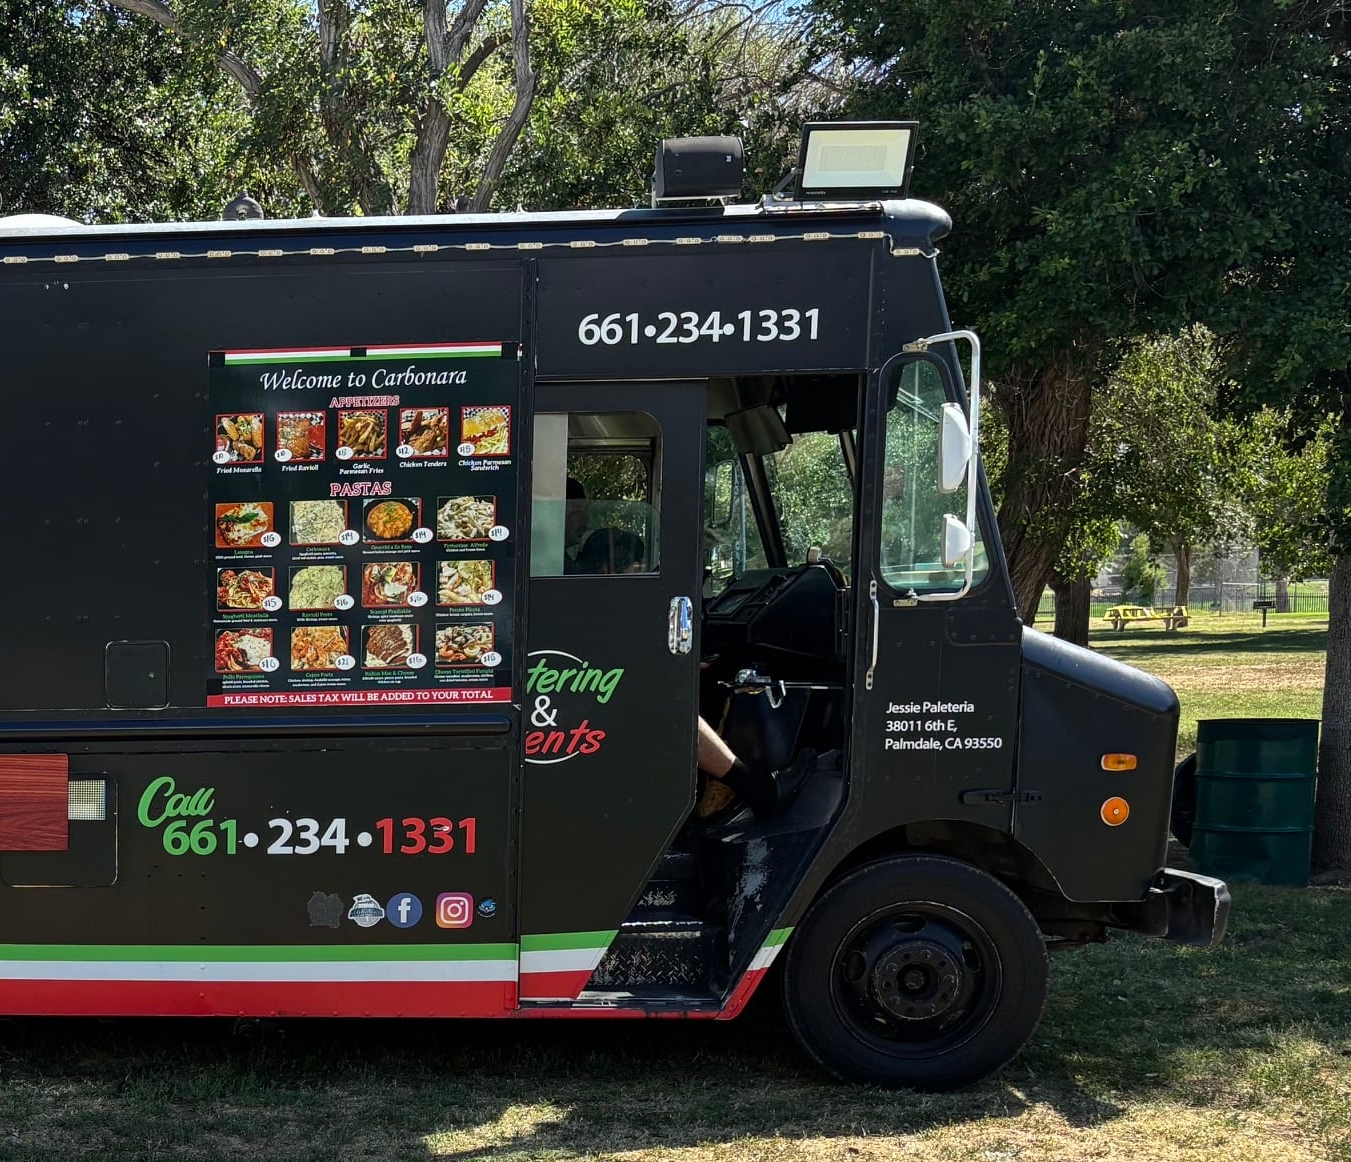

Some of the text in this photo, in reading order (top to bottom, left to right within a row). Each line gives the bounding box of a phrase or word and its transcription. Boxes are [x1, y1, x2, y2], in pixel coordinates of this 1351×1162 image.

[260, 365, 467, 391] Welcome to Carbonara
[329, 395, 400, 408] APPETIZERS
[329, 481, 392, 497] PASTAS
[224, 690, 493, 704] PLEASE NOTE: SALES TAX WILL BE ADDED TO YOUR TOTAL
[530, 695, 558, 727] &
[885, 701, 975, 714] Jessie Paleteria
[885, 720, 958, 733] 38011 6th E,
[525, 719, 606, 755] ents
[885, 737, 1002, 751] Palmdale, CA 93550
[137, 776, 215, 827] Call
